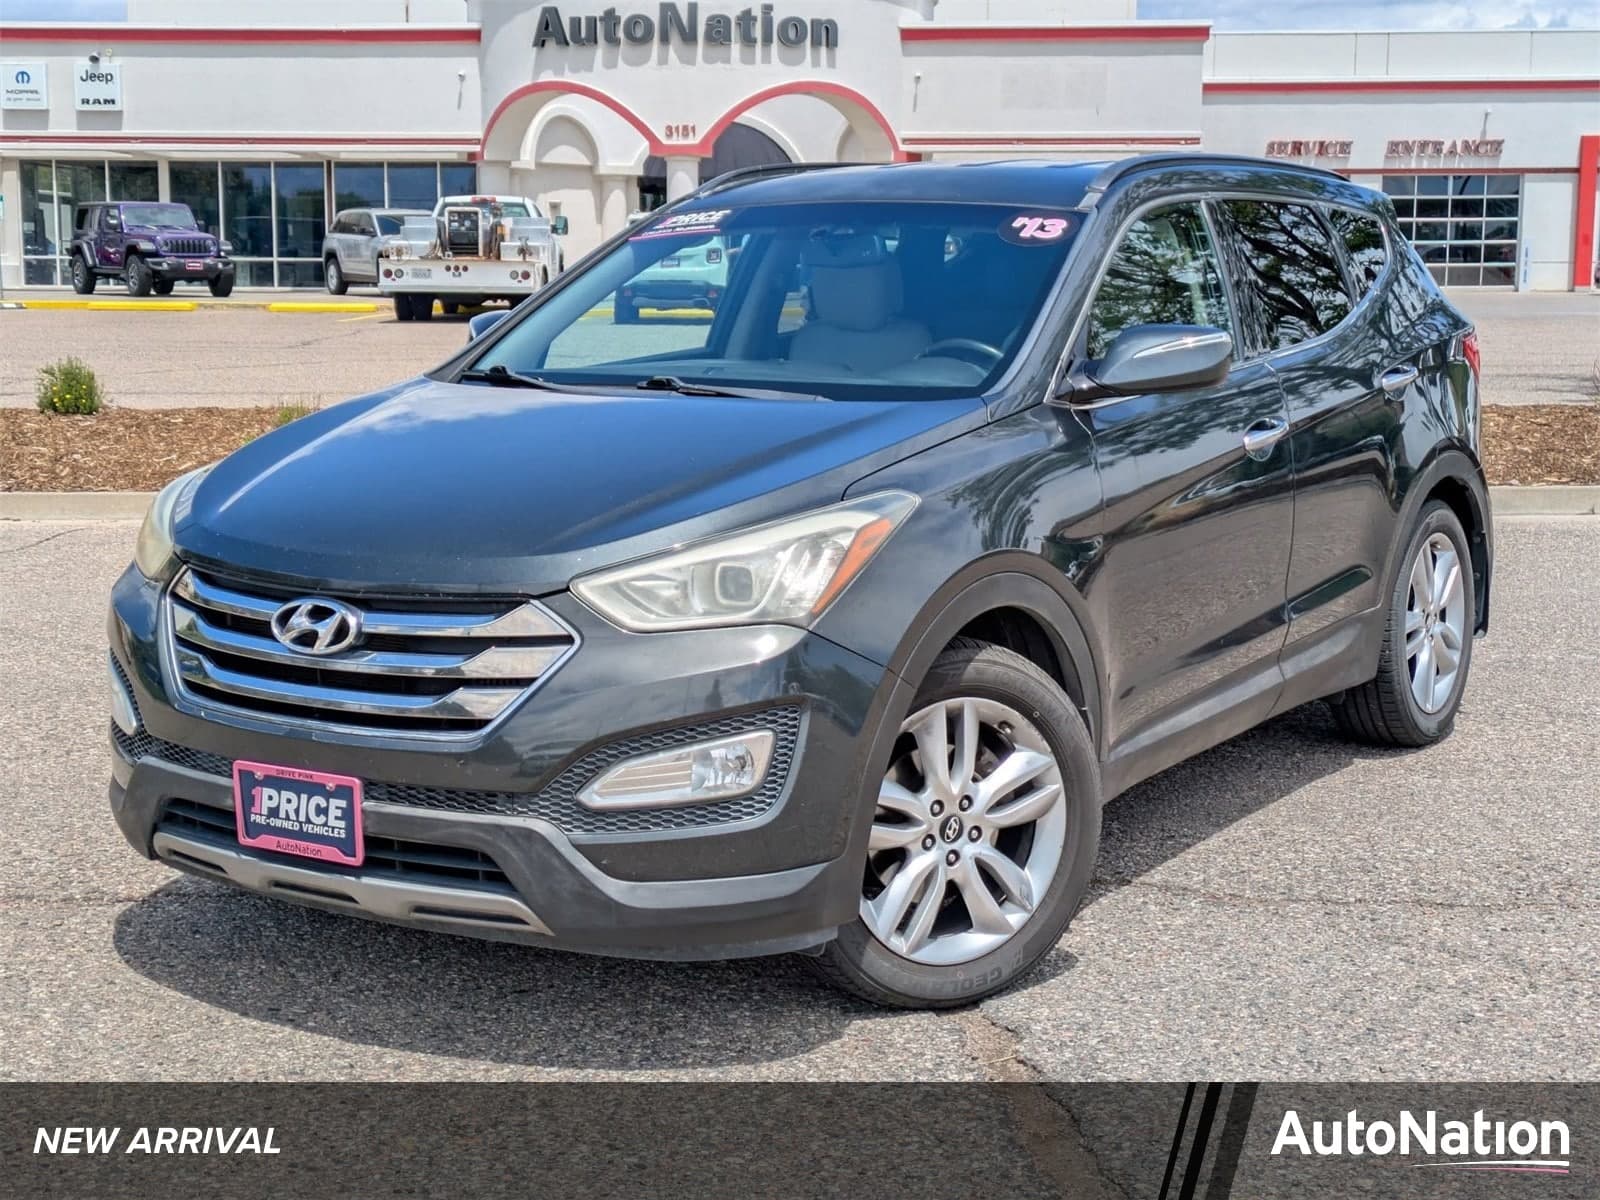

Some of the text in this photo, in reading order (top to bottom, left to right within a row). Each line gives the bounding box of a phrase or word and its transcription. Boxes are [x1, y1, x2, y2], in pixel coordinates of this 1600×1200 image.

[532, 2, 838, 48] AutoNation
[80, 69, 114, 84] Jeep
[80, 97, 116, 105] RAM
[1265, 139, 1504, 158] SERVICE ENTRANCE
[251, 786, 347, 828] 1PRICE
[250, 813, 346, 838] PRE-OWNED VEHICLES
[276, 840, 322, 857] AutoNation
